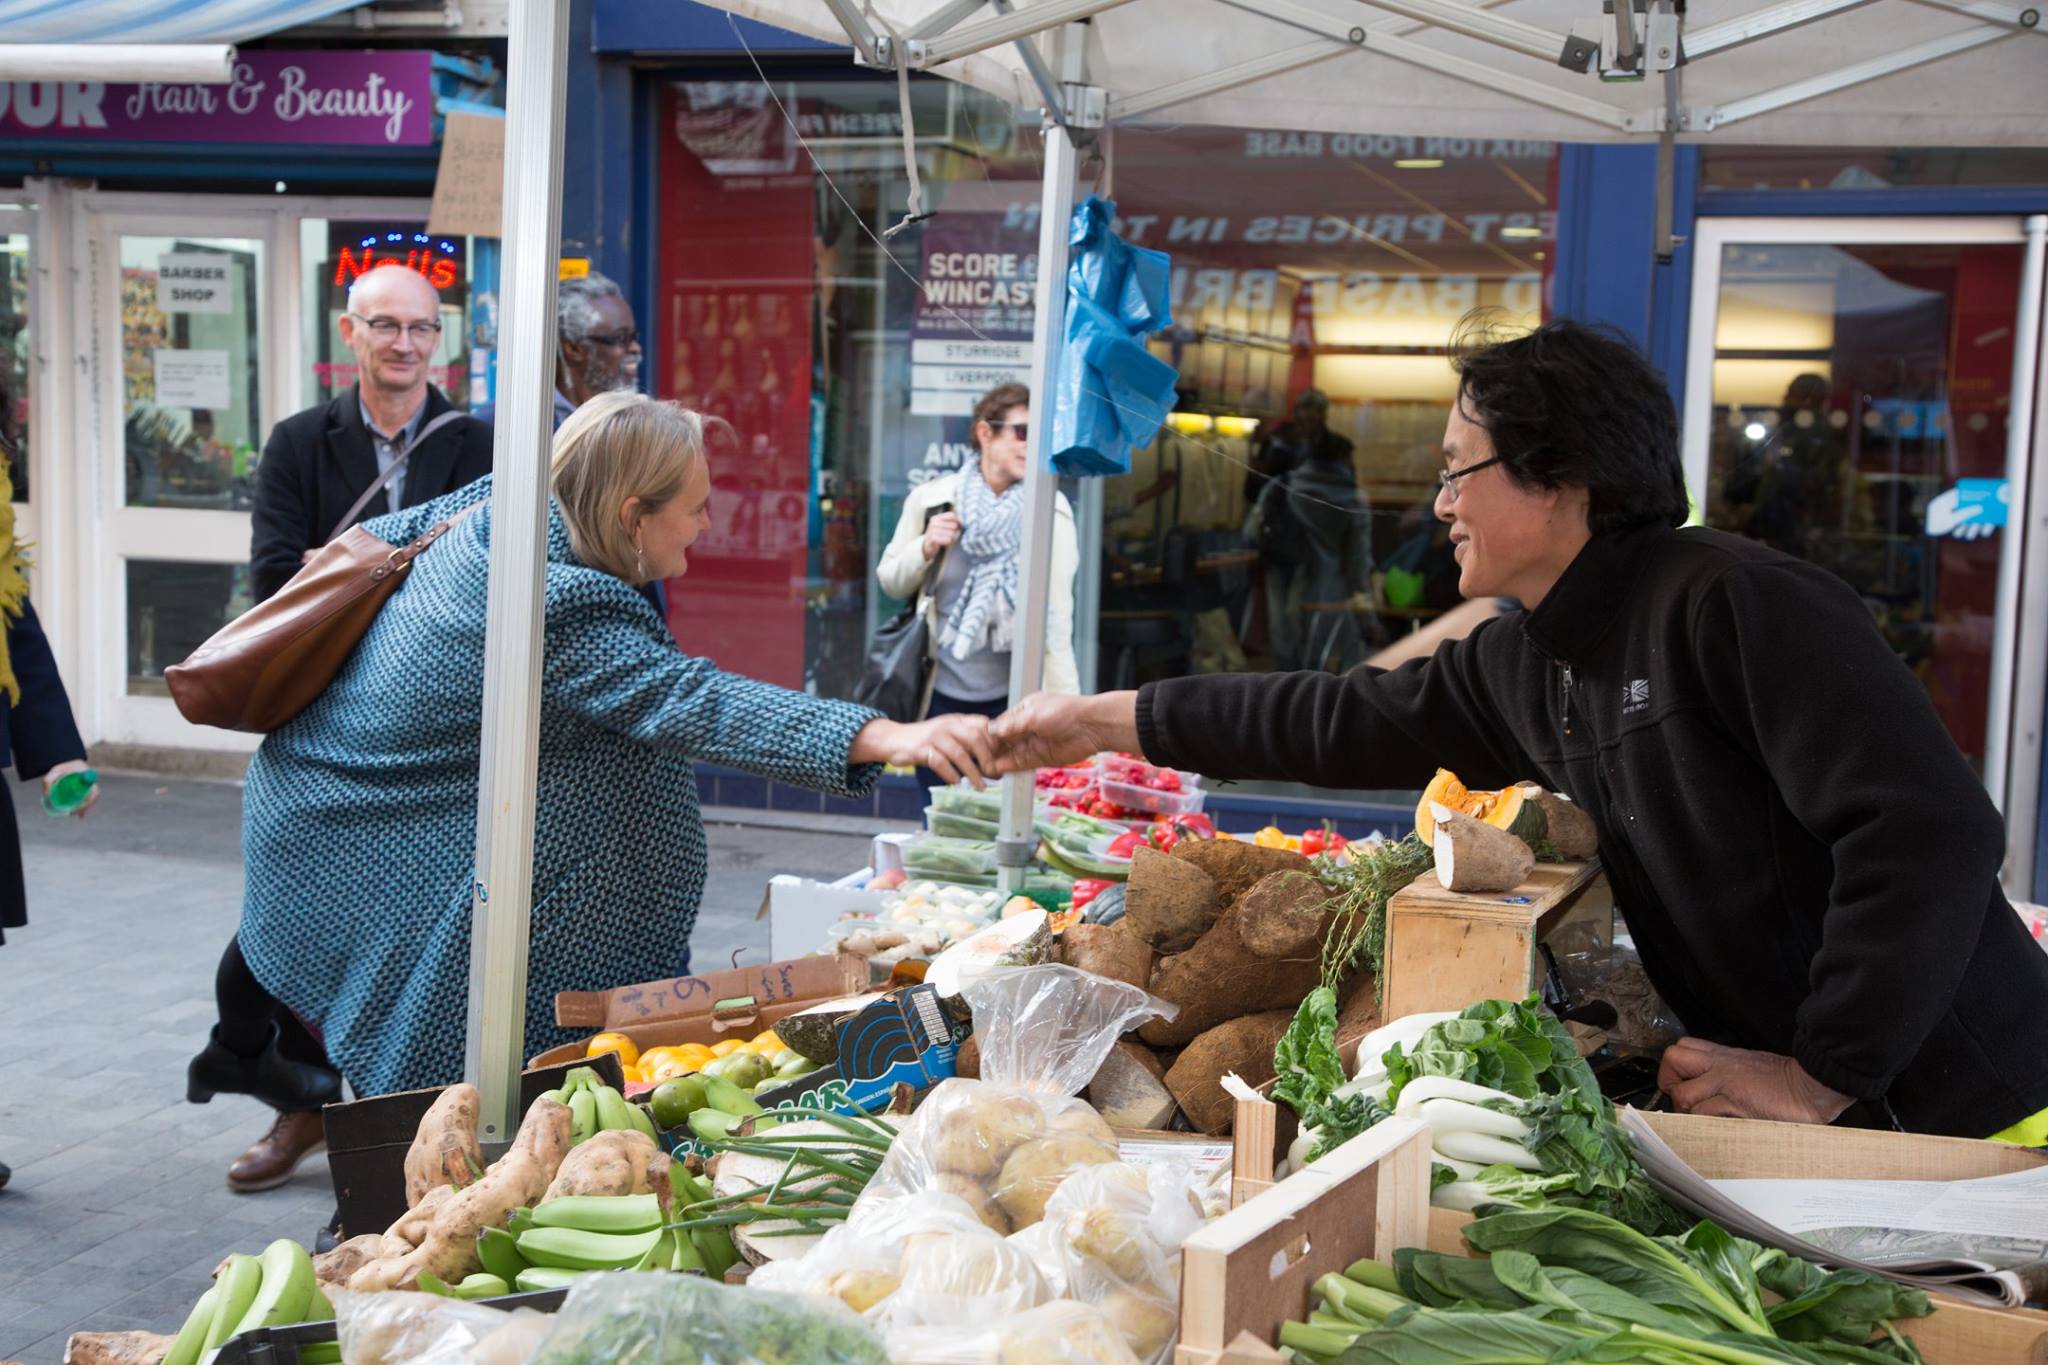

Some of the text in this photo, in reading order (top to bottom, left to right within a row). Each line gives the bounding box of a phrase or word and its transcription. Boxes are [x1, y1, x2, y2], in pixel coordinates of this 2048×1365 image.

[0, 81, 108, 128] UR
[227, 63, 266, 114] &
[274, 66, 413, 143] Beauty
[159, 266, 226, 280] BARBER
[335, 247, 457, 289] Nils
[929, 252, 1017, 278] SCORE
[170, 287, 216, 302] SHOP
[945, 344, 1022, 358] STURRIDGE
